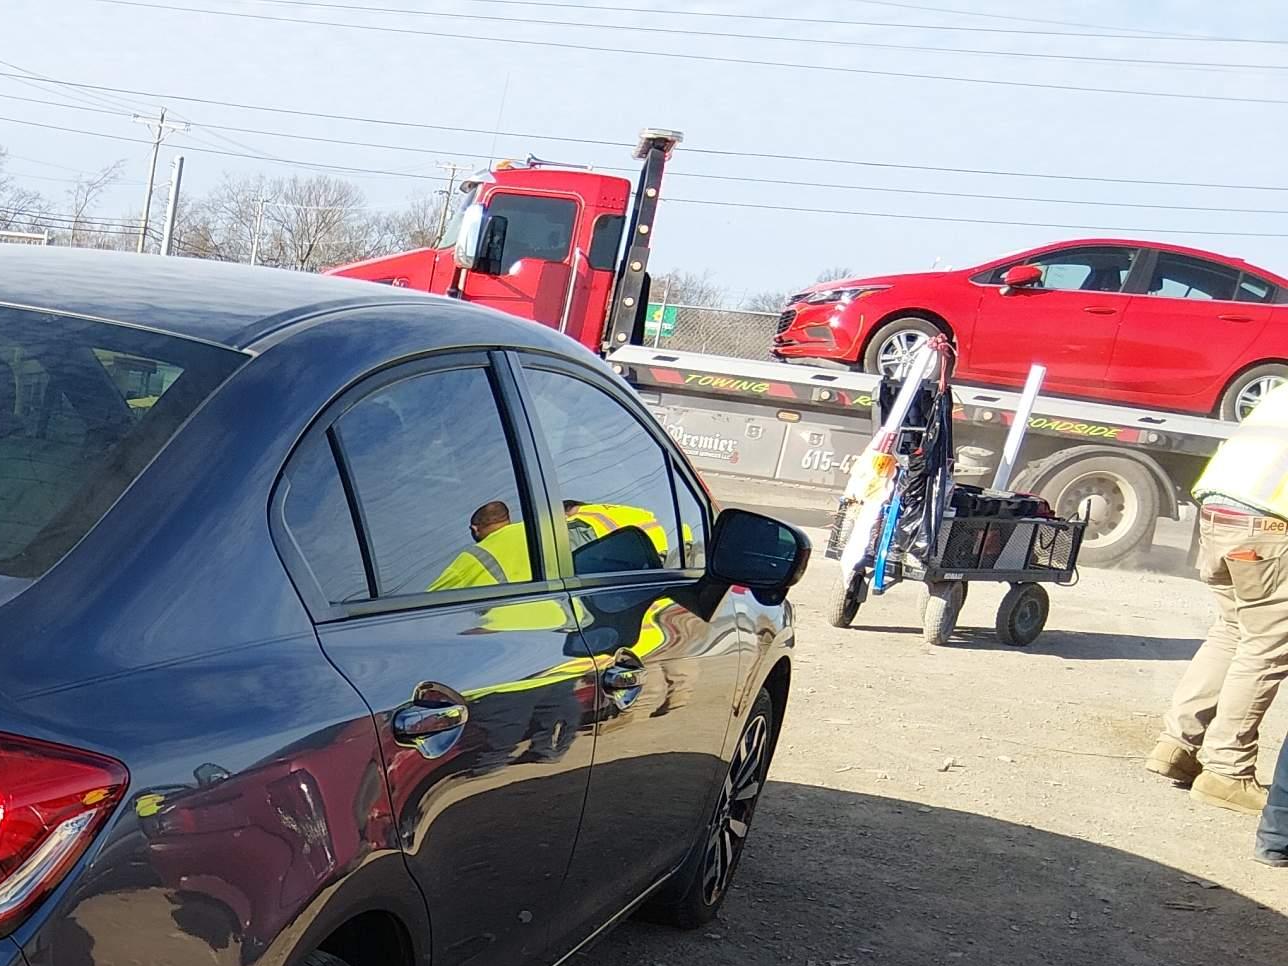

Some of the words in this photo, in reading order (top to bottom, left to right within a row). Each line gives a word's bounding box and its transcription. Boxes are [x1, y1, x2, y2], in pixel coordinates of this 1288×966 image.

[684, 373, 769, 393] TOWING
[667, 423, 738, 453] Premier
[1263, 520, 1285, 532] Lee
